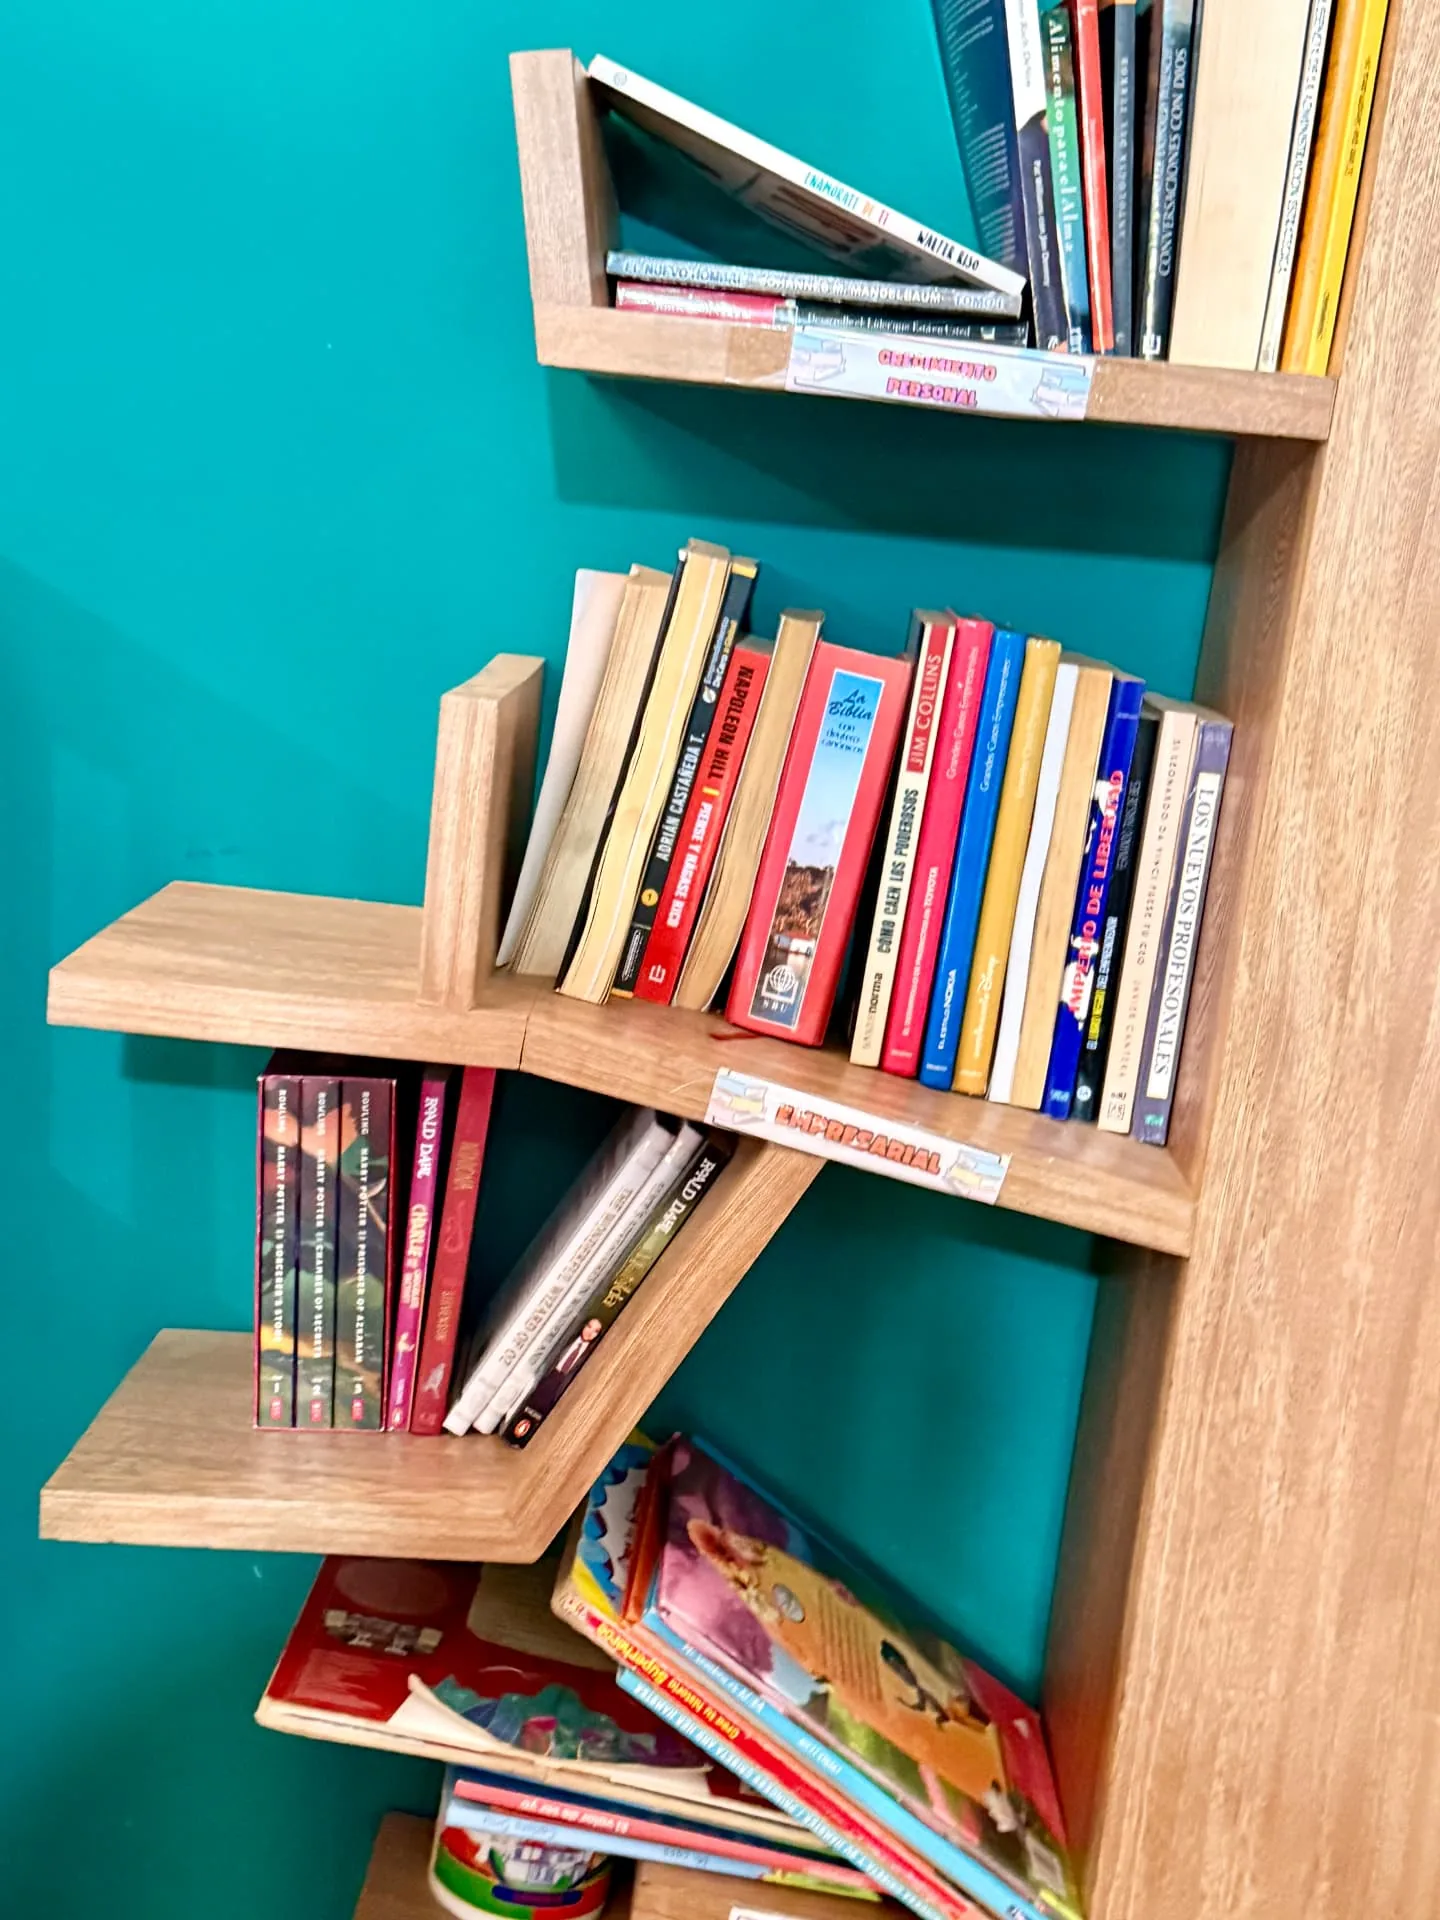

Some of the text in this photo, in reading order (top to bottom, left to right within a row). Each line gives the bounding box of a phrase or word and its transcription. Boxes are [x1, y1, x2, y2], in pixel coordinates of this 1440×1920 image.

[1047, 17, 1071, 122] Alimento
[1172, 47, 1187, 89] DIOS
[1168, 93, 1183, 131] CON
[1051, 123, 1070, 173] para
[1060, 195, 1080, 253] Alma
[1158, 133, 1180, 276] CONVERSACIONES
[915, 229, 982, 273] WALTER RISO
[886, 377, 979, 406] PERSONAL
[717, 665, 754, 745] NAPOLEON
[910, 652, 941, 766] JIM COLLINS
[668, 744, 701, 815] CASTAÑEDA
[707, 747, 730, 781] HILL
[894, 787, 919, 857] PODEROSOS
[1193, 788, 1213, 829] LOS
[889, 859, 906, 882] LOS
[1065, 768, 1125, 1014] IMPERIO DE LIBERTAD
[1178, 833, 1206, 916] NUEVOS
[883, 885, 901, 916] CAEN
[868, 972, 882, 1014] norma
[360, 1091, 370, 1135] ROWLING
[416, 1095, 439, 1179] ROALD DAHL
[276, 1146, 285, 1181] HARRY
[315, 1148, 325, 1183] HARRY
[359, 1148, 368, 1182] HARRY
[275, 1183, 284, 1224] POTTER
[314, 1186, 324, 1227] POTTER
[358, 1185, 367, 1226] POTTER
[652, 1156, 717, 1239] ROALD DAHL
[356, 1243, 366, 1296] PRISONER
[355, 1298, 364, 1312] OF
